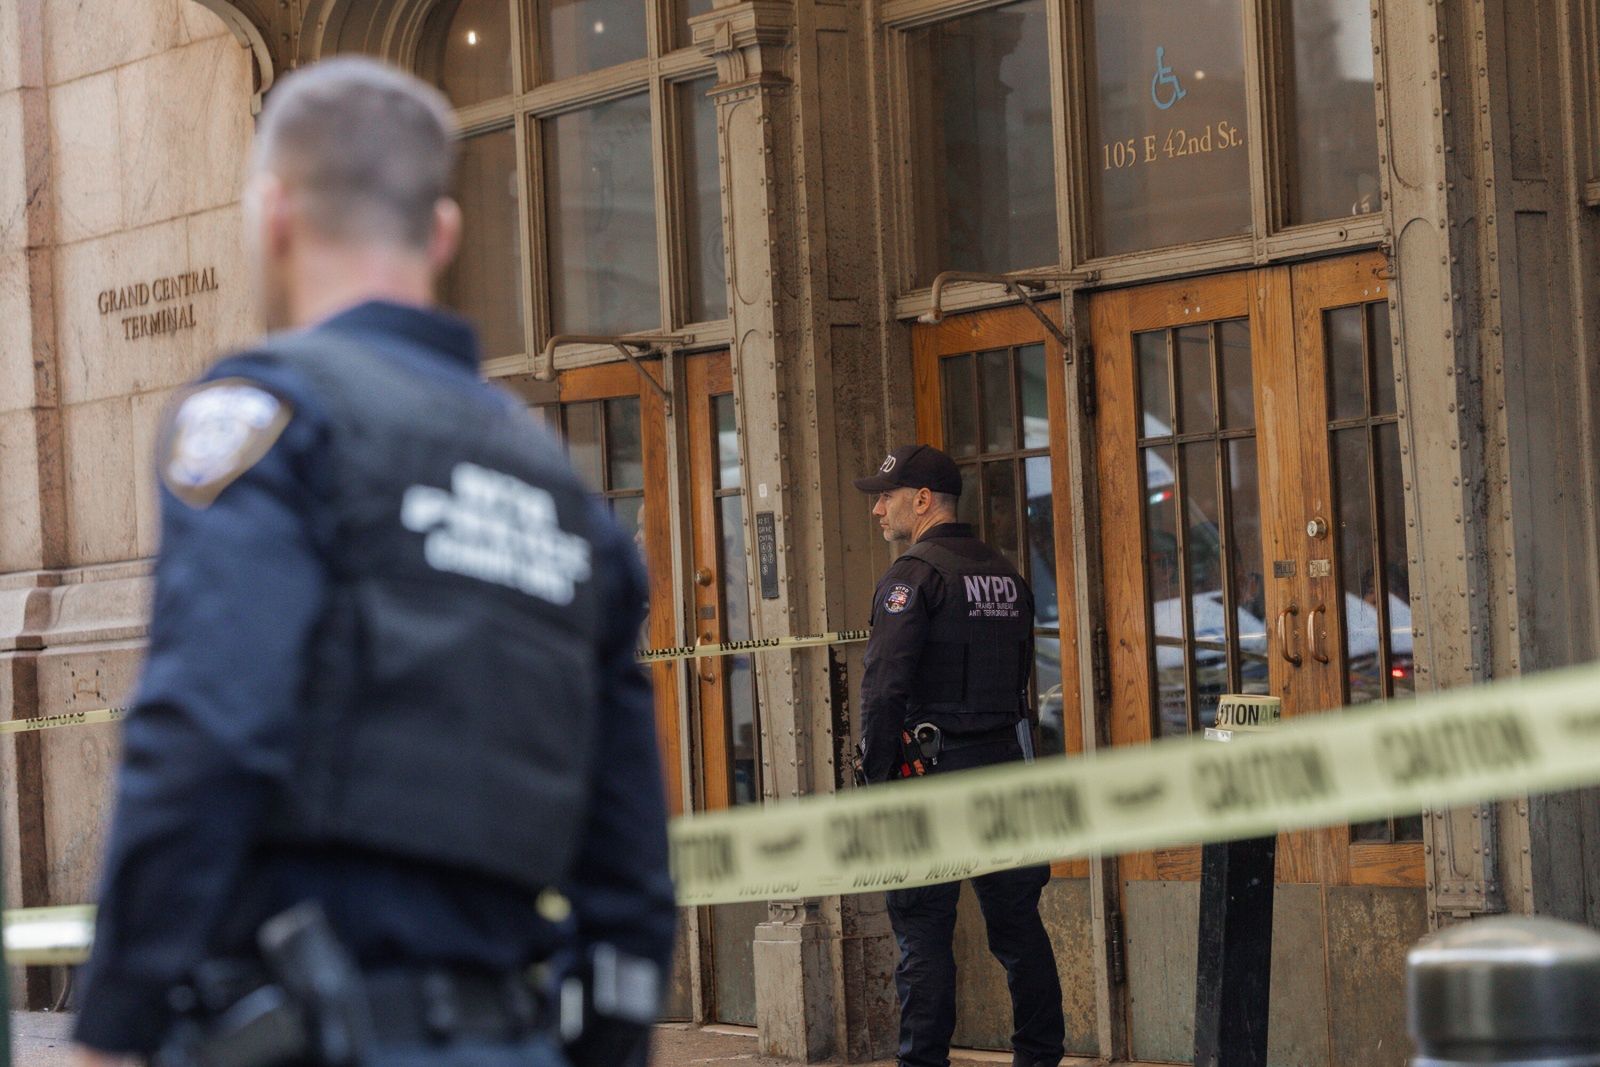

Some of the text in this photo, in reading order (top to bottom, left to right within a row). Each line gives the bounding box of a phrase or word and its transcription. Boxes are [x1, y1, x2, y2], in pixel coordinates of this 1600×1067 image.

[1103, 121, 1243, 170] 105 E 42nd St.
[98, 266, 219, 315] GRAND CENTRAL
[121, 303, 197, 340] TERMINAL
[963, 575, 1018, 603] NYPD
